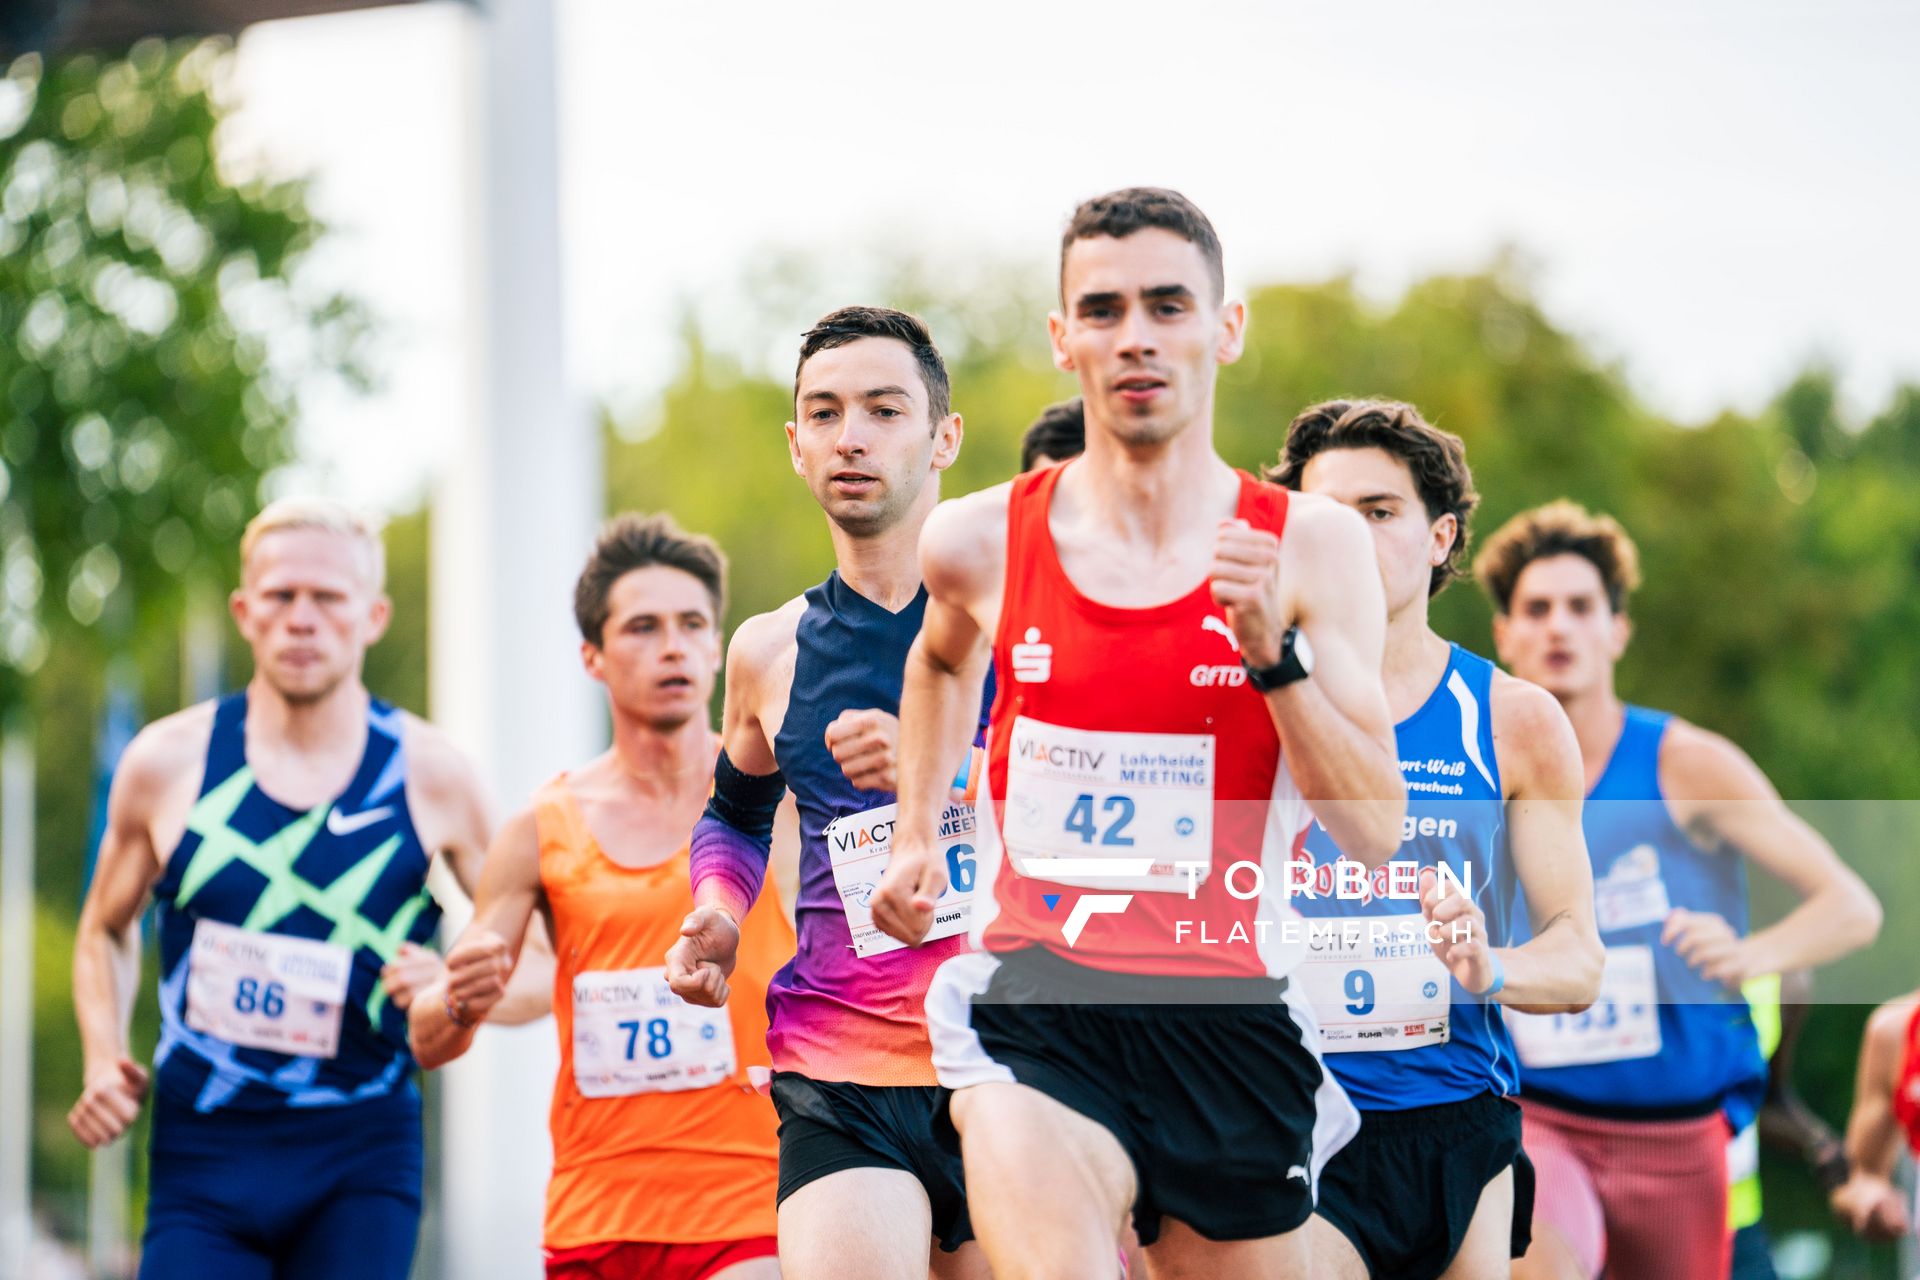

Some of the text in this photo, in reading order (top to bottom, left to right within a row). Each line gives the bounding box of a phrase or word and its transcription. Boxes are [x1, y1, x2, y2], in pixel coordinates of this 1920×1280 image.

[1018, 738, 1105, 770] VIACTIV
[1119, 770, 1205, 786] MEETING
[1407, 781, 1463, 795] reschach
[938, 816, 976, 836] MEET
[1064, 793, 1136, 846] 42
[1400, 816, 1458, 841] gen
[834, 820, 896, 852] VIACT
[945, 843, 977, 892] 6
[936, 912, 961, 924] RUHR
[1309, 933, 1360, 951] CTIV
[1375, 944, 1432, 958] MEETIN
[236, 977, 286, 1019] 86
[1343, 969, 1375, 1016] 9
[618, 1018, 672, 1060] 78
